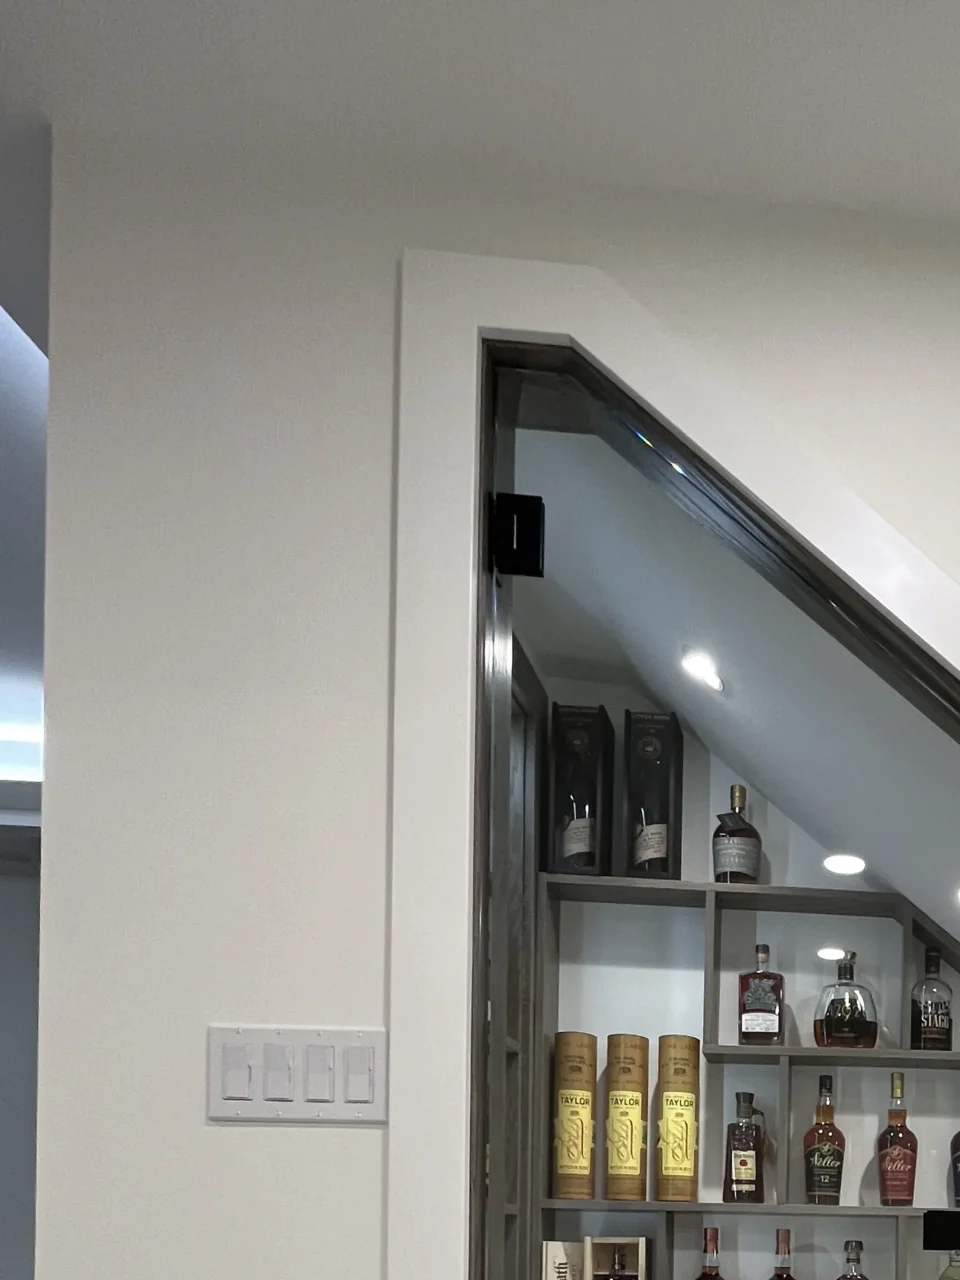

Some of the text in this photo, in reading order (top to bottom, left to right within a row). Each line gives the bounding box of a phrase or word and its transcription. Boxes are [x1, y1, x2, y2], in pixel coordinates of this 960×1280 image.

[560, 1096, 590, 1106] TAYLOR
[610, 1097, 640, 1107] TAYLOR
[665, 1098, 694, 1108] TAYLOR
[810, 1152, 841, 1168] Weller
[821, 1175, 830, 1183] 12
